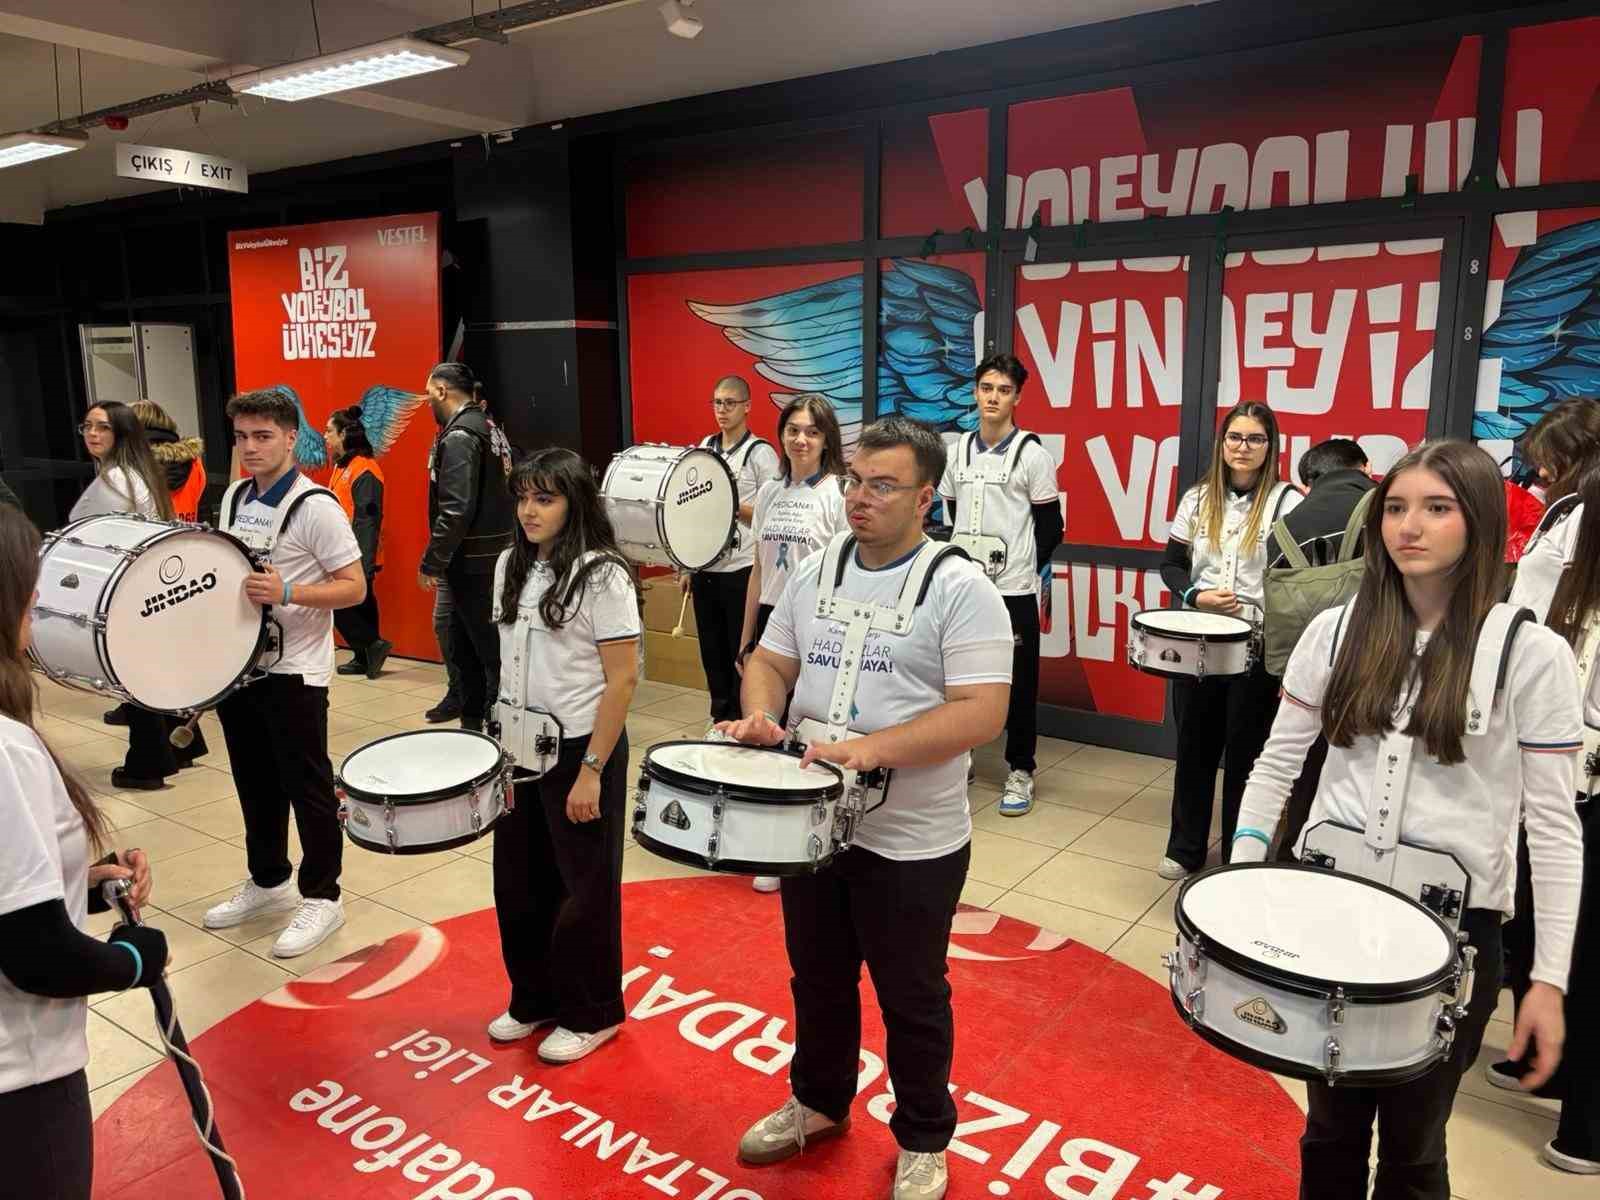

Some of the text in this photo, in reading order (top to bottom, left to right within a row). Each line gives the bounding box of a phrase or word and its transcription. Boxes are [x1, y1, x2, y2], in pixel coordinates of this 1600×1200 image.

[131, 155, 173, 175] ÇIKIŞ
[201, 164, 232, 180] EXIT
[299, 246, 349, 291] BİZ
[281, 288, 371, 323] VOLEYBOL
[282, 321, 377, 361] ÜLKESİYİZ
[811, 637, 843, 655] HAD
[374, 1028, 493, 1085] LİGİ
